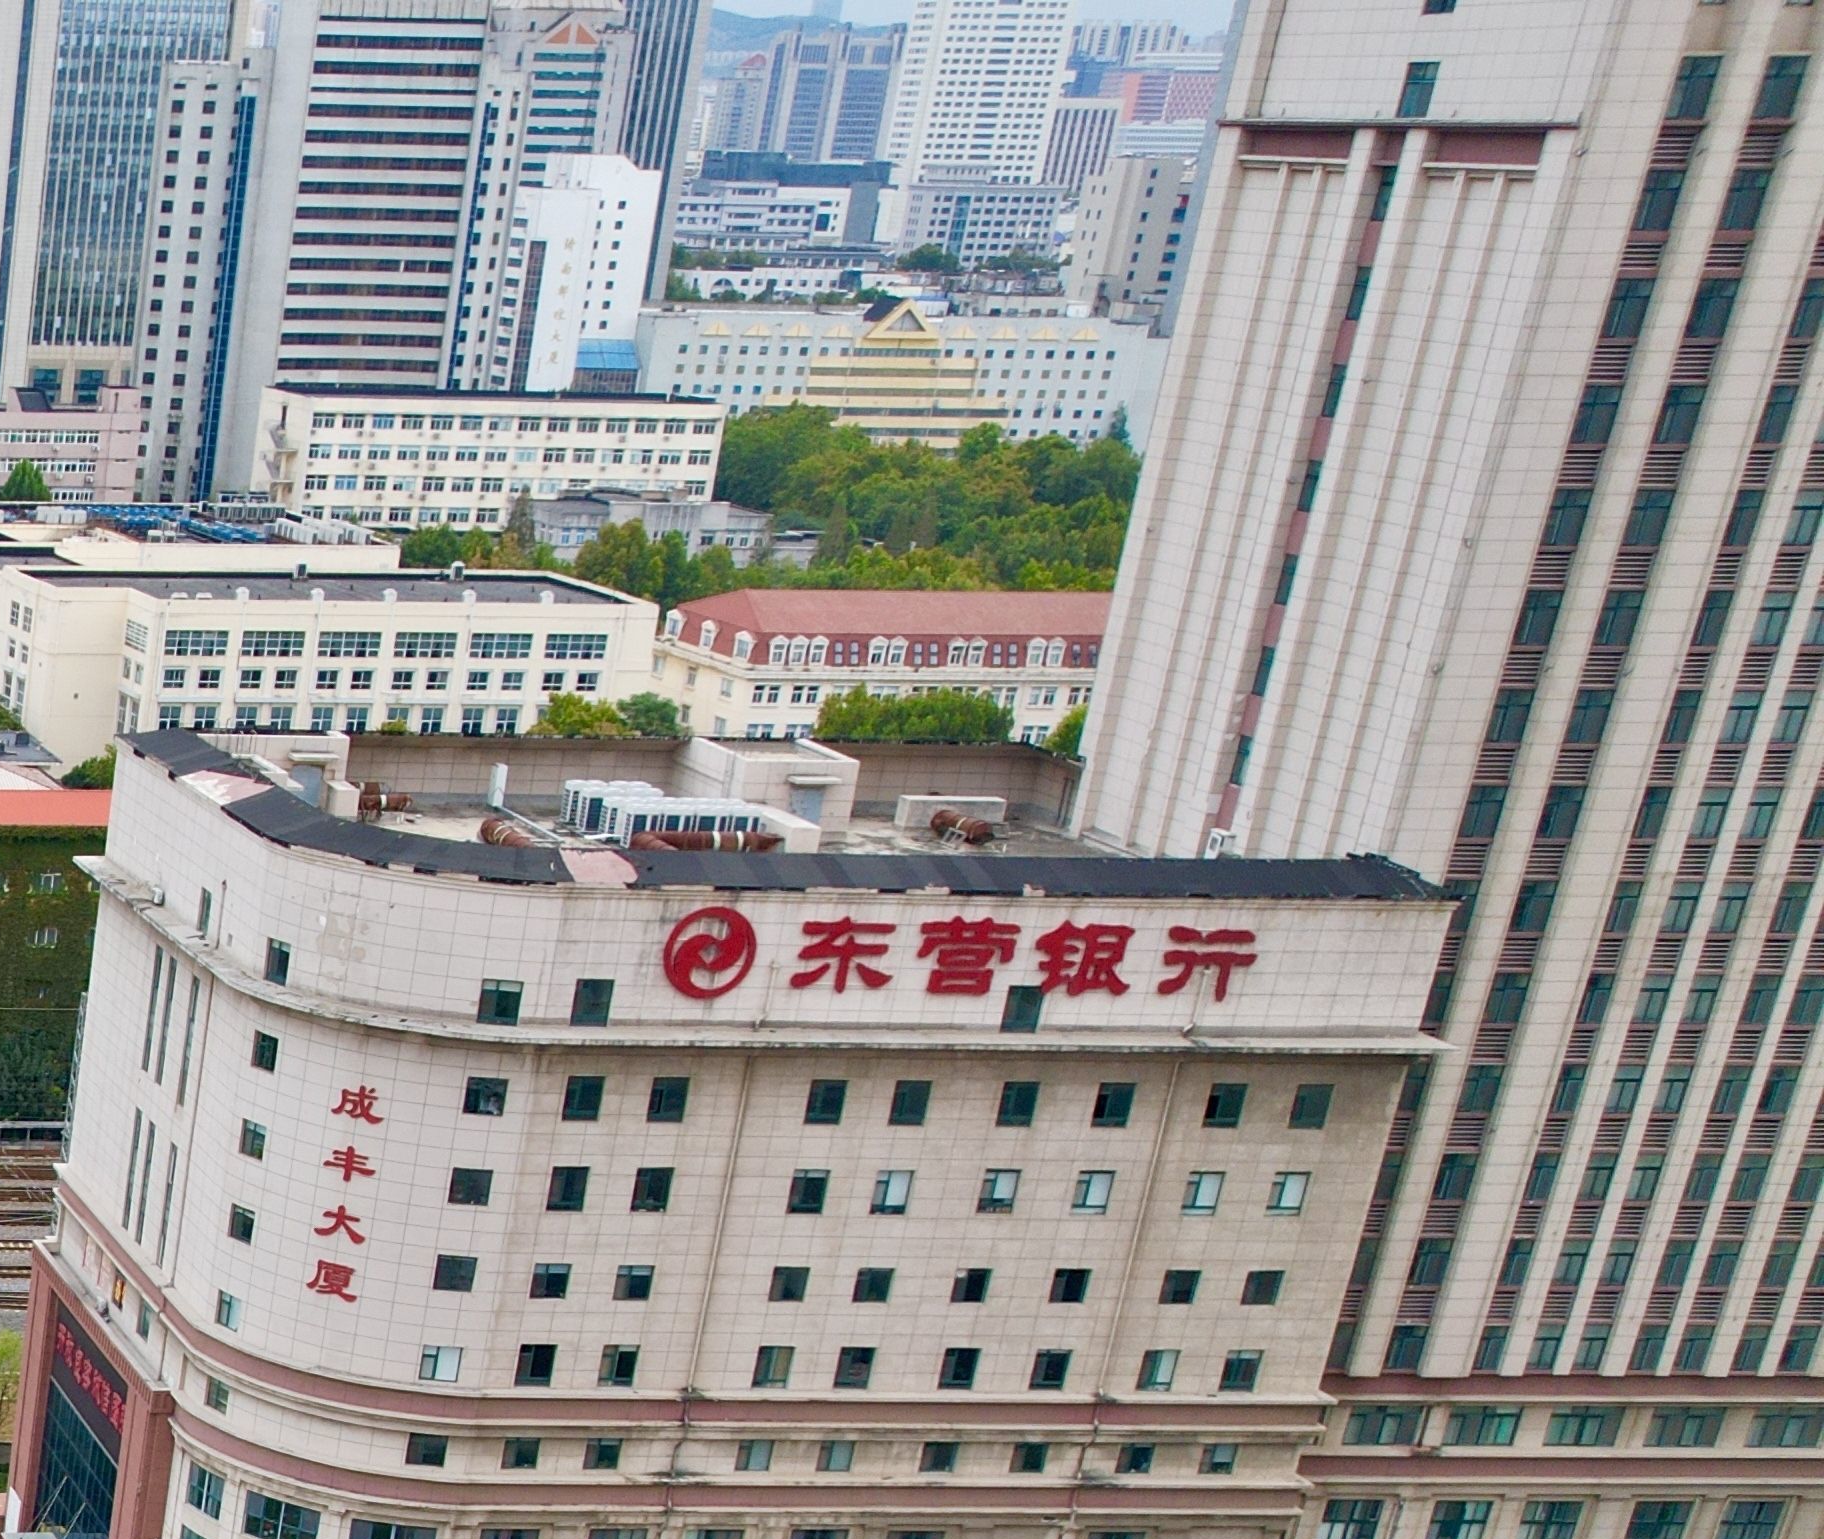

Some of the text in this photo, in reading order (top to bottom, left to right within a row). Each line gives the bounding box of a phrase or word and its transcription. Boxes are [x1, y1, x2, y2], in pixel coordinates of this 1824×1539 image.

[790, 915, 1257, 1002] 东营银行
[306, 1085, 385, 1303] 成丰大厦
